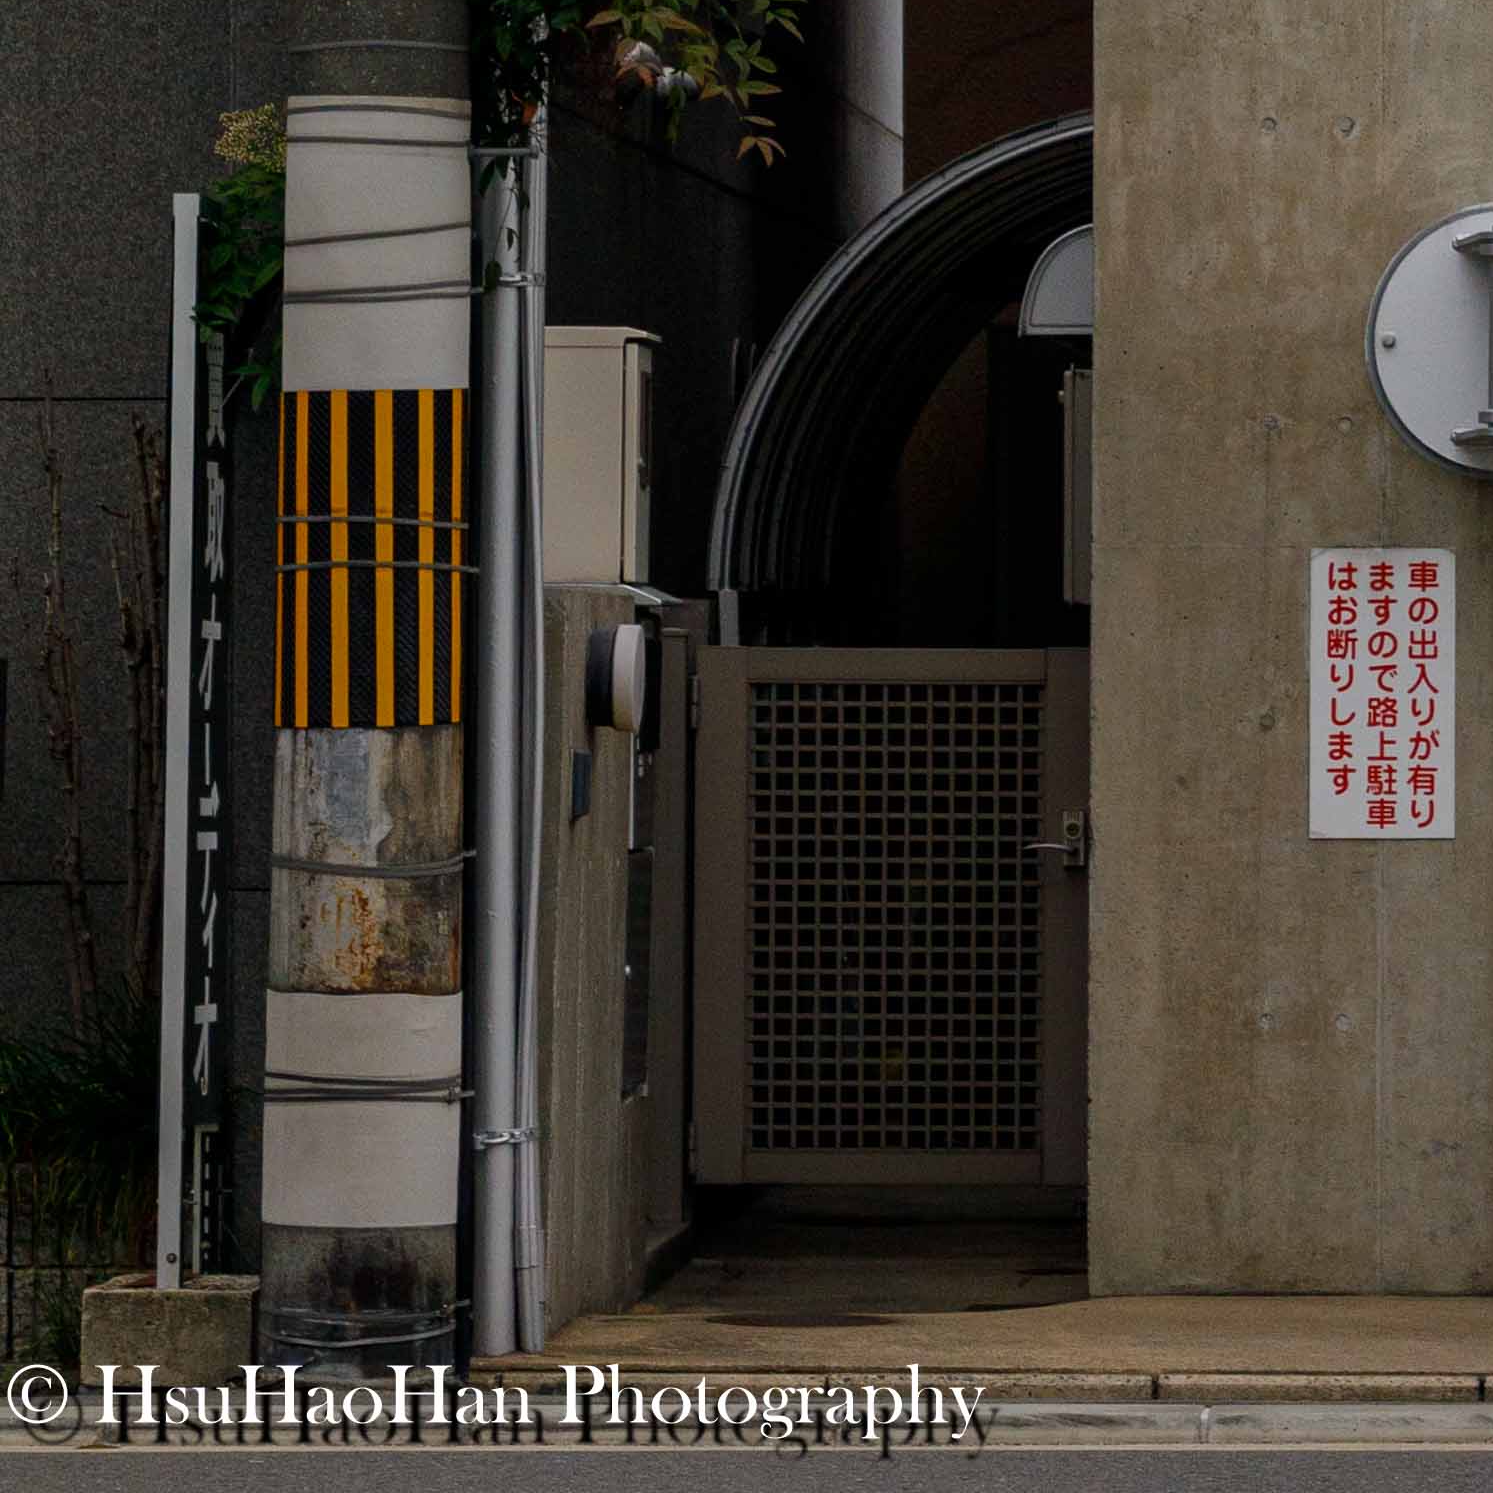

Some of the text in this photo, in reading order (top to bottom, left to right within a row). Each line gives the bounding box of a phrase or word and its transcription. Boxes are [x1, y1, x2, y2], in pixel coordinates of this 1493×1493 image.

[1327, 562, 1358, 795] はお断りします
[1366, 562, 1398, 829] ますので路上駐車
[1407, 561, 1439, 828] 車の出入りが有り
